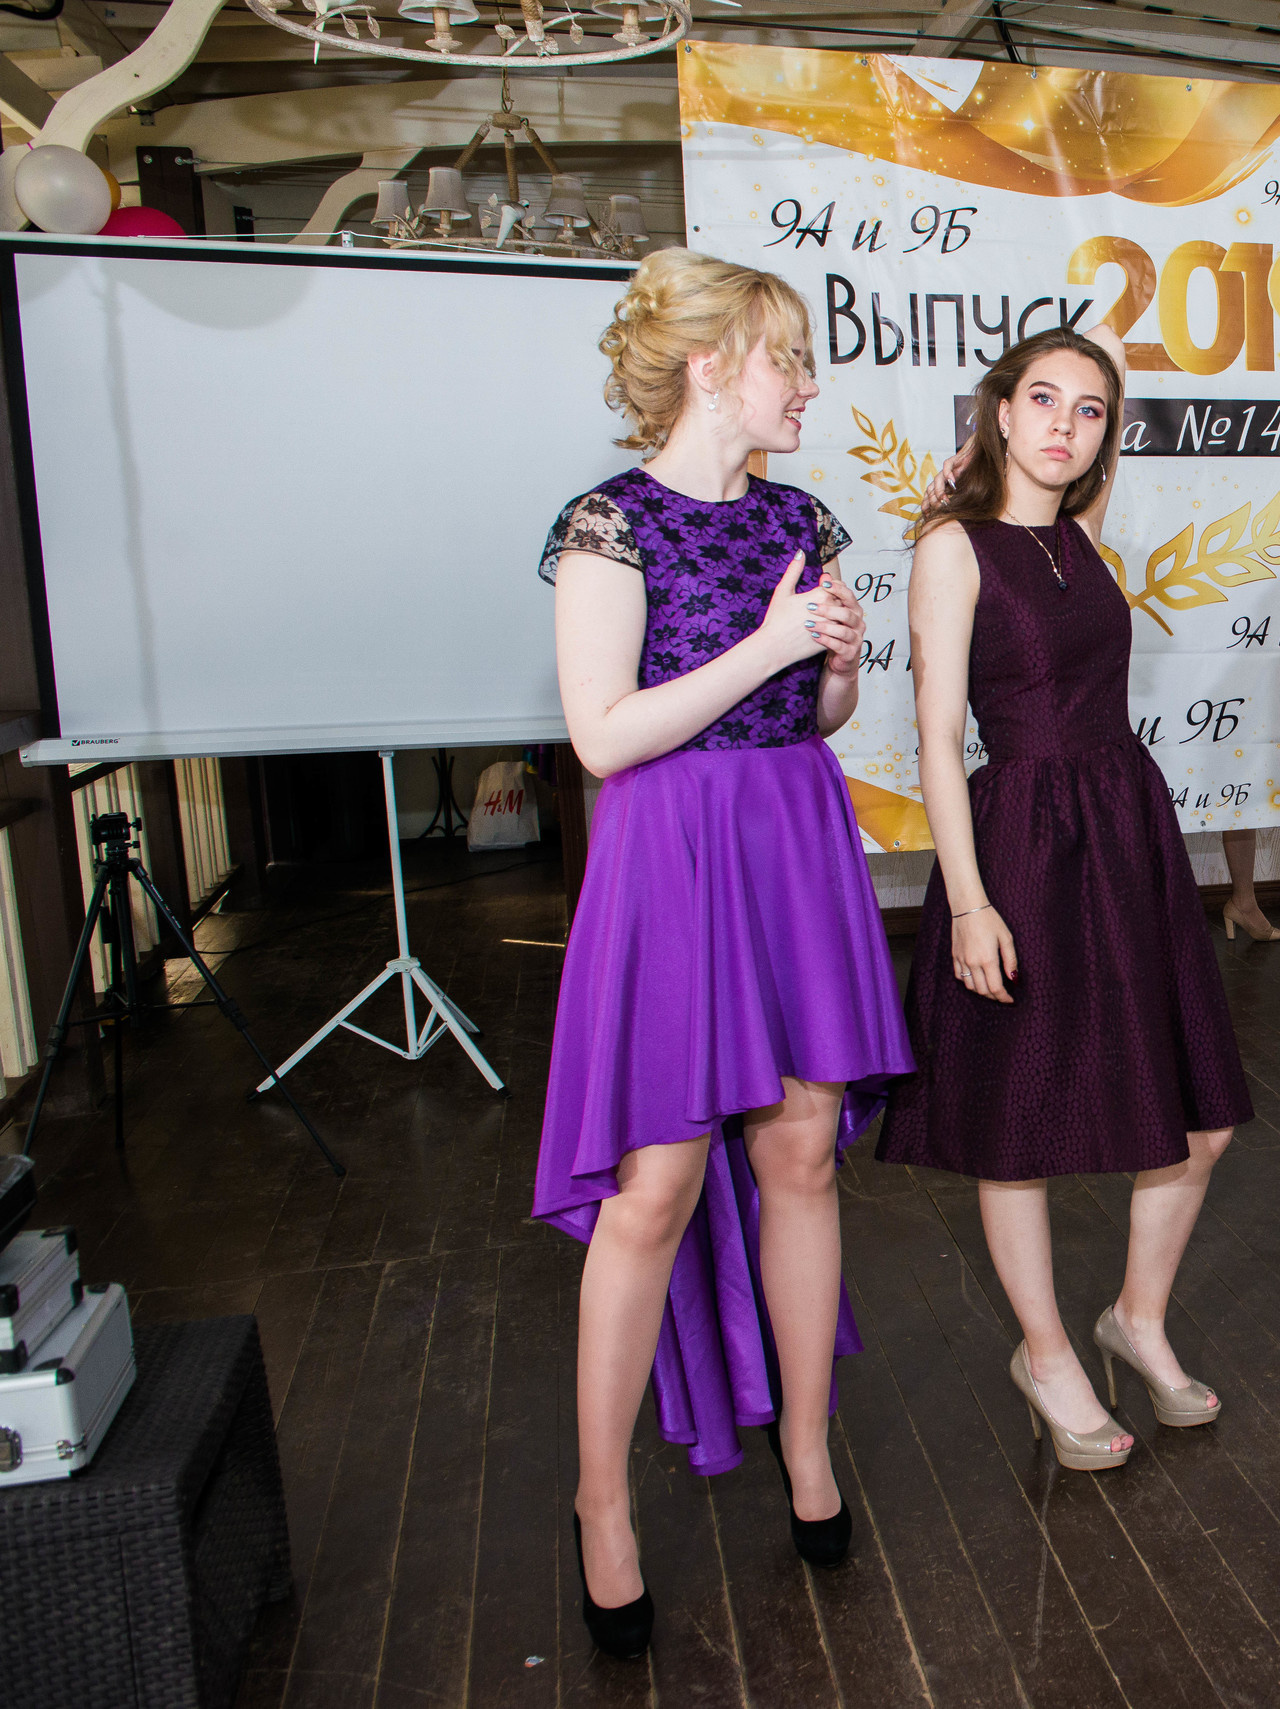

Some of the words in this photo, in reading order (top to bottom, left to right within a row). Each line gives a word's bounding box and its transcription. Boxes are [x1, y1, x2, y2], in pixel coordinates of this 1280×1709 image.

[763, 198, 837, 250] 9А
[852, 220, 888, 253] и
[903, 205, 979, 255] 9Б
[854, 572, 896, 603] 9Б
[1226, 615, 1271, 649] 9А
[1136, 716, 1166, 746] и
[1179, 697, 1245, 744] 9Б
[483, 789, 524, 816] H&M
[1195, 793, 1212, 808] и
[1217, 783, 1252, 806] 9Б
